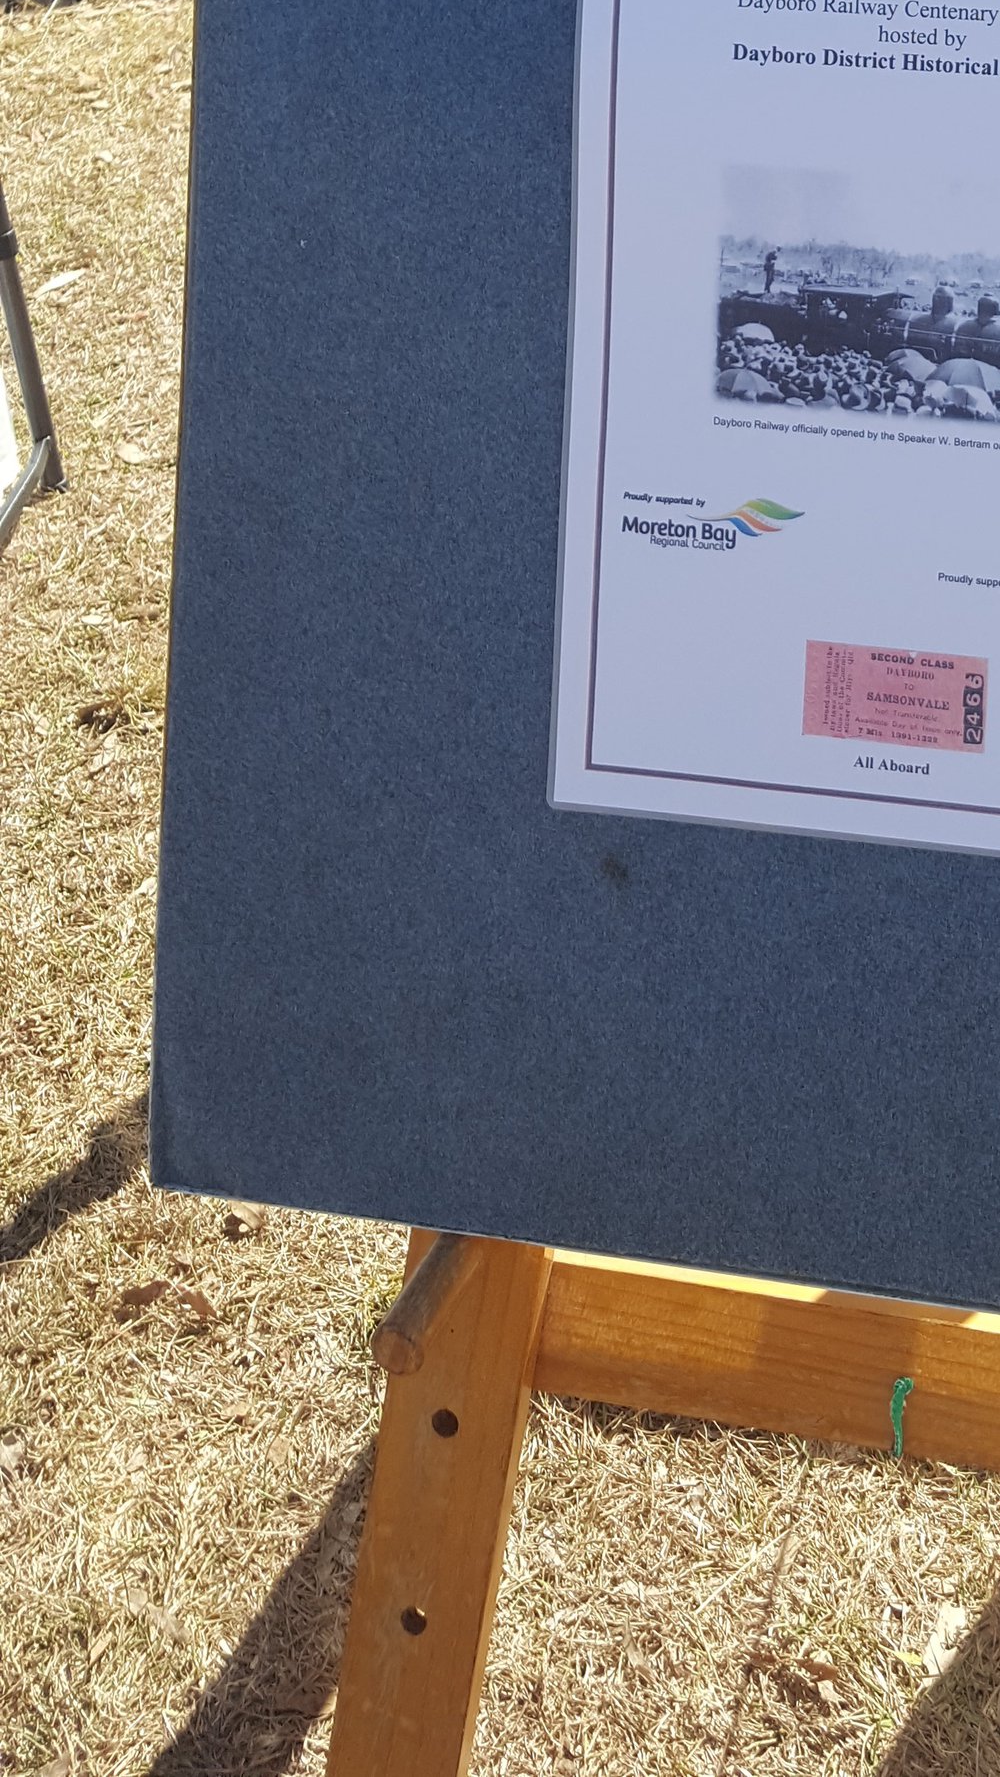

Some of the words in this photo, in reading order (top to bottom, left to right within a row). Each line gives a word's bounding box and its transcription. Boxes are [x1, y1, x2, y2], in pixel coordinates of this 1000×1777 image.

[905, 1, 998, 26] Centenary
[879, 25, 937, 45] hosted
[945, 29, 967, 51] by
[734, 44, 816, 66] Dayboro
[823, 49, 895, 69] District
[903, 54, 998, 75] Historical
[713, 416, 752, 429] Dayboro
[754, 420, 789, 433] Railway
[792, 423, 828, 436] officially
[831, 427, 865, 439] opened
[867, 428, 878, 441] by
[880, 430, 895, 441] the
[897, 432, 936, 446] Speaker
[938, 435, 952, 446] W.
[954, 436, 991, 448] Bertram
[624, 492, 652, 502] Proudly
[656, 495, 692, 505] supported
[696, 498, 705, 507] by
[622, 516, 697, 538] Moreton
[701, 523, 737, 550] Bay
[650, 534, 689, 548] Regional
[692, 538, 725, 551] Council
[938, 573, 973, 585] Proudly
[871, 653, 914, 665] SECOND
[921, 659, 955, 669] CLASS
[886, 667, 935, 680] DAYBORO
[905, 683, 915, 691] TO
[867, 692, 950, 710] SAMSONVALE
[854, 756, 873, 768] All
[878, 759, 929, 775] Aboard
